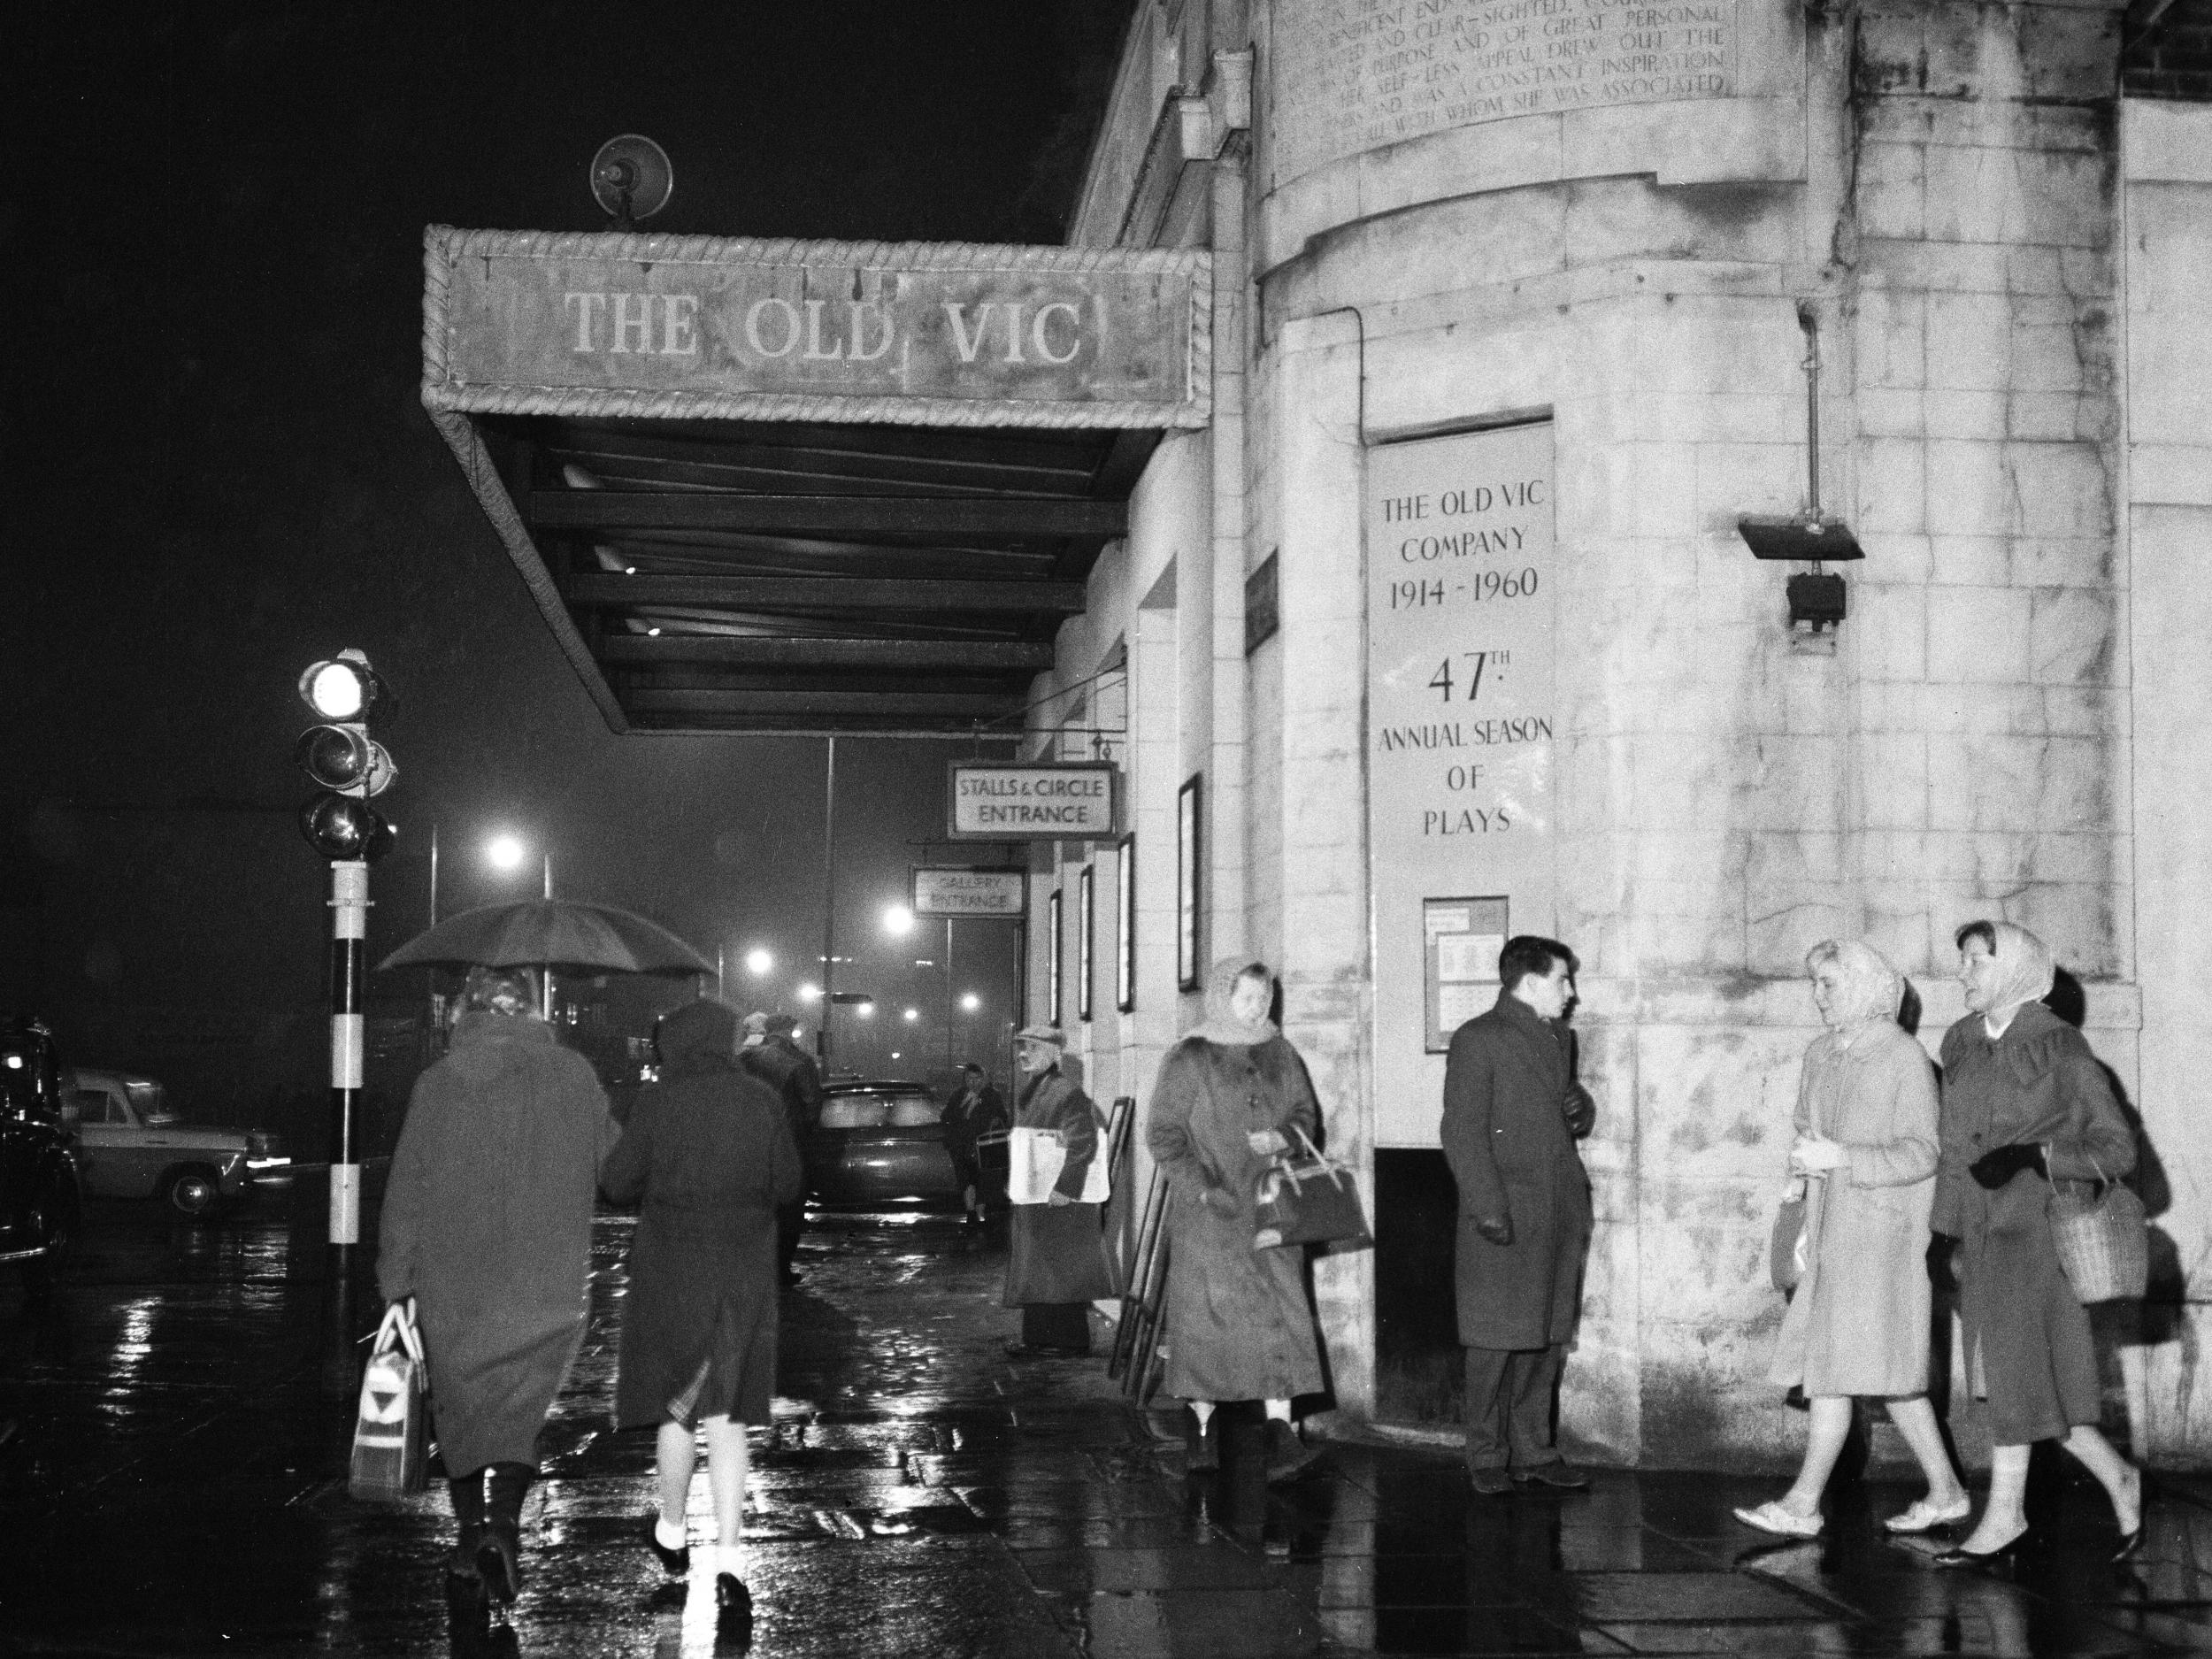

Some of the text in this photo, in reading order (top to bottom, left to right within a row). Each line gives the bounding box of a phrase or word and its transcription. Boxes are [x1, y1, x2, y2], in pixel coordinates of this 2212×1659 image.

[1453, 32, 1490, 53] AND
[1504, 25, 1527, 44] OF
[1542, 13, 1605, 36] GREAT
[1625, 5, 1724, 27] PERSONAL
[1619, 29, 1668, 50] OUT
[1686, 27, 1724, 46] THE
[1601, 50, 1724, 76] INSPIRATION
[1446, 96, 1503, 120] WHOM
[1513, 89, 1543, 108] SHE
[1553, 84, 1591, 103] WAS
[1601, 73, 1724, 98] ASSOCIATED
[564, 291, 1082, 364] THE OLD VIC
[1381, 480, 1545, 522] THE OLD VIC
[1401, 526, 1529, 564] COMPANY
[1391, 577, 1446, 609] 1914
[1474, 567, 1539, 602] 1960
[1378, 715, 1553, 752] ANNUAL SEASON
[959, 779, 1018, 796] STALLS
[1033, 779, 1104, 797] CIRCLE
[1447, 764, 1485, 792] OF
[978, 805, 1088, 824] ENTRANCE
[1424, 806, 1511, 836] PLAYS
